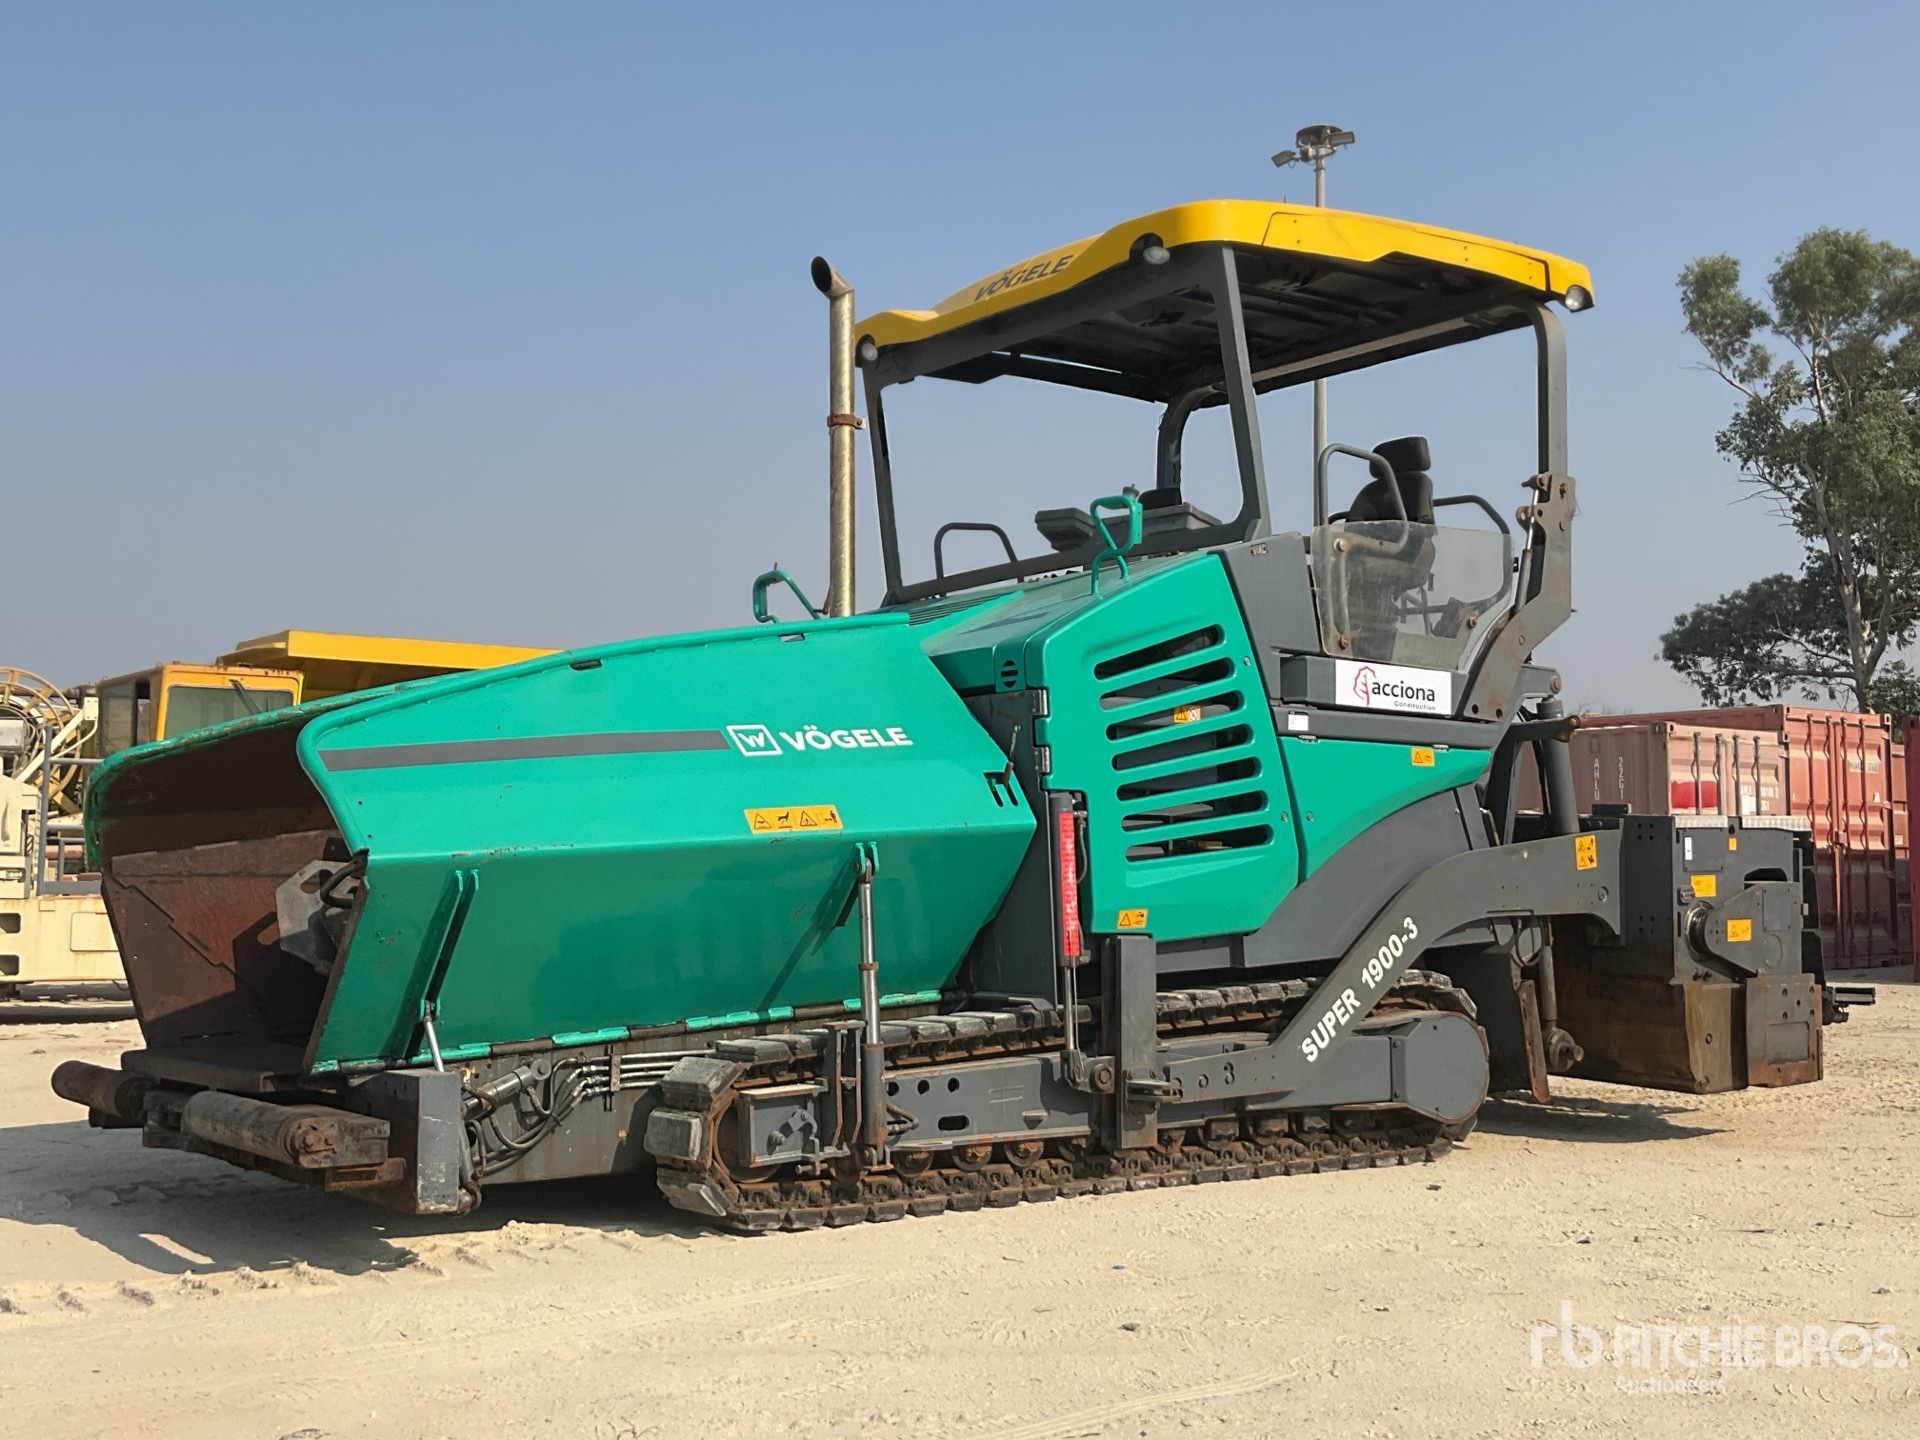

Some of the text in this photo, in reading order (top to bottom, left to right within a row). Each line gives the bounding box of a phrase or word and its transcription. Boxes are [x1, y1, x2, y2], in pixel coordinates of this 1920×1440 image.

[974, 254, 1074, 302] VÖGELE
[1371, 681, 1436, 702] acciona
[1394, 701, 1436, 711] Construction
[779, 725, 914, 751] VÖGELE
[1301, 916, 1418, 1062] SUPER 1900-3
